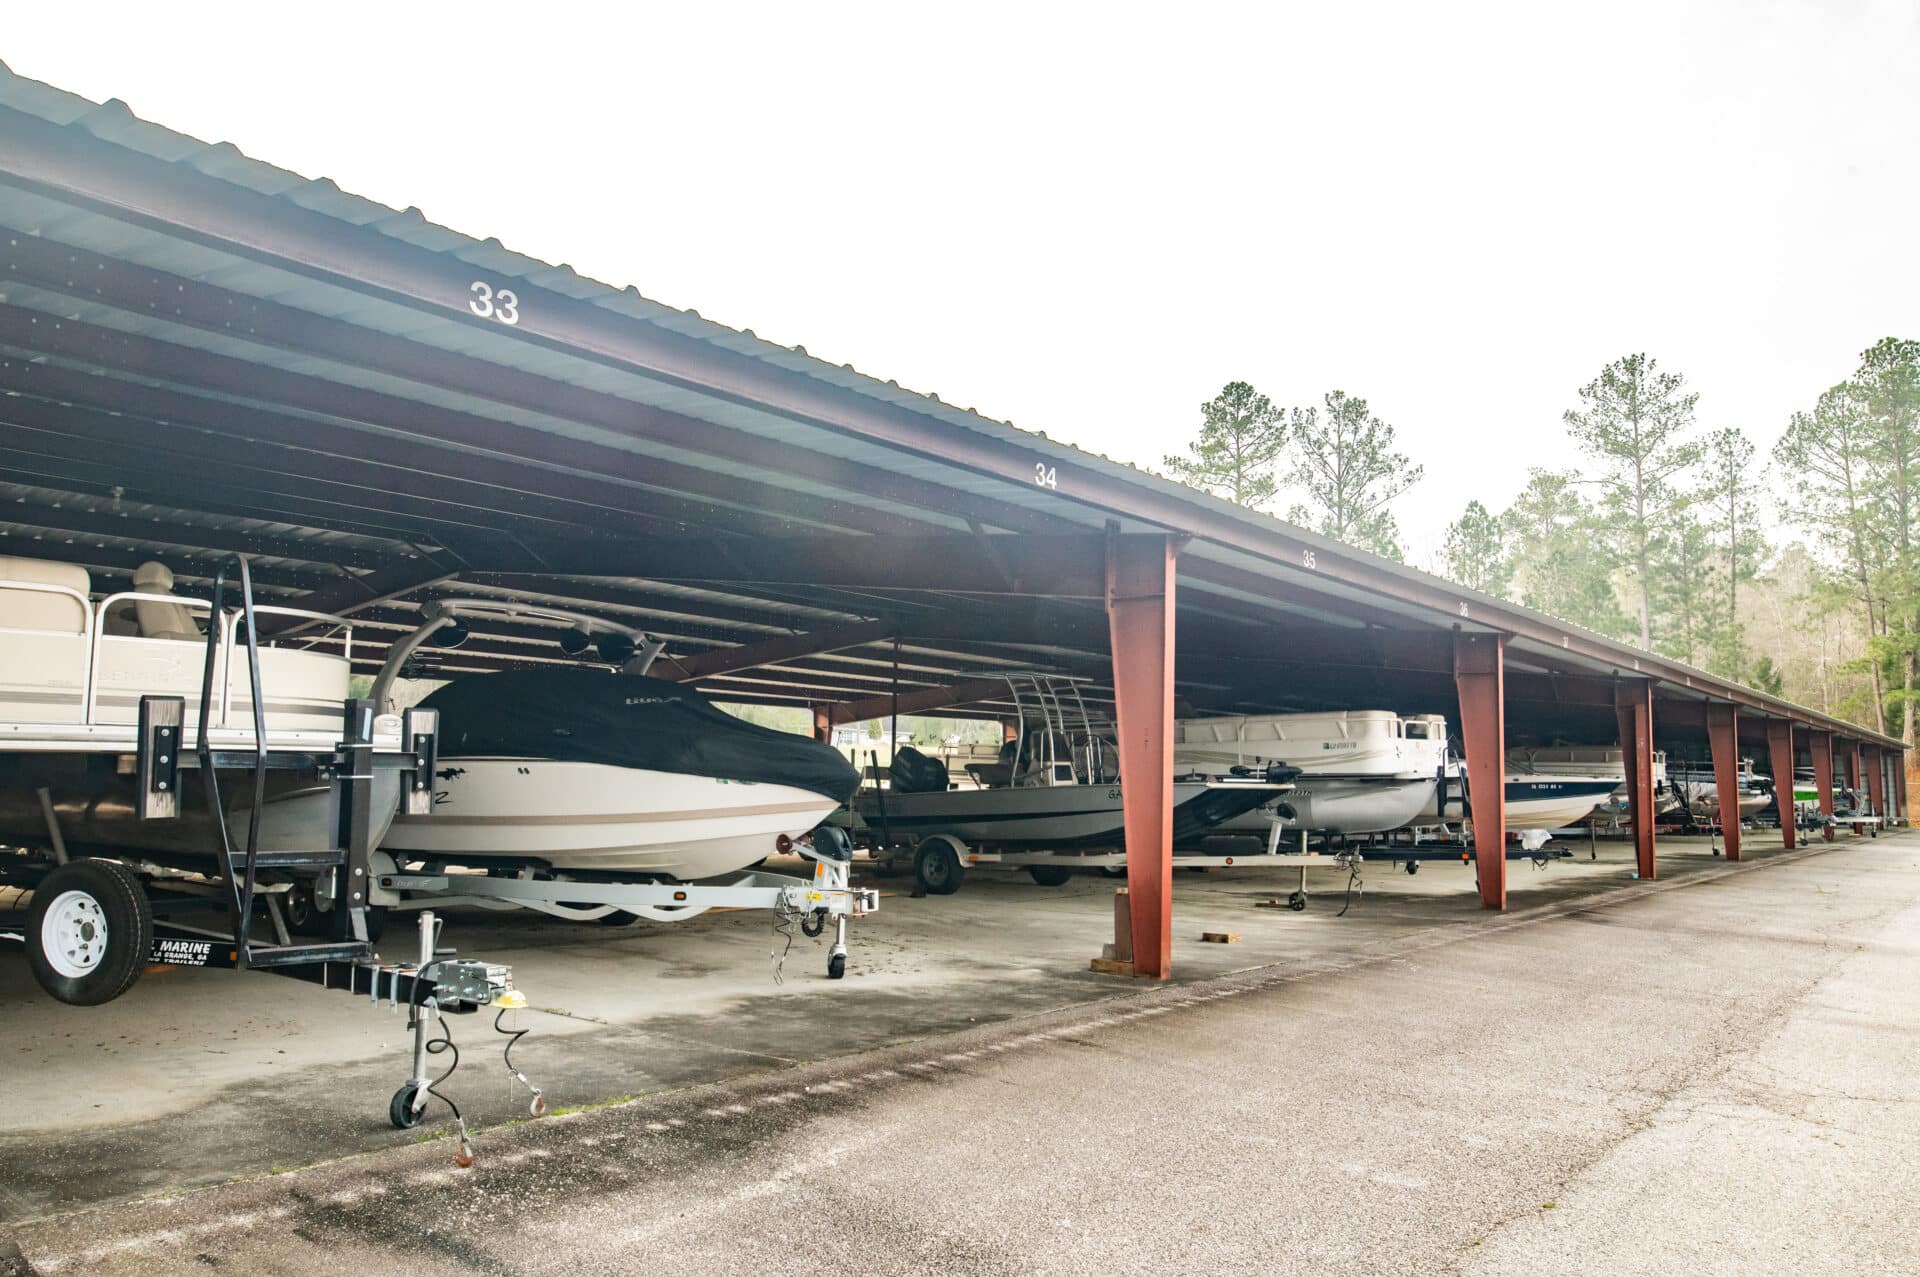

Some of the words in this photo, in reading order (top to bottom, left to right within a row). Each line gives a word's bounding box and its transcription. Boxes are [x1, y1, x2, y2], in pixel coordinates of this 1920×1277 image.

[470, 281, 519, 325] 33
[1035, 462, 1057, 490] 34
[1303, 549, 1316, 569] 35
[160, 940, 212, 954] MARINE
